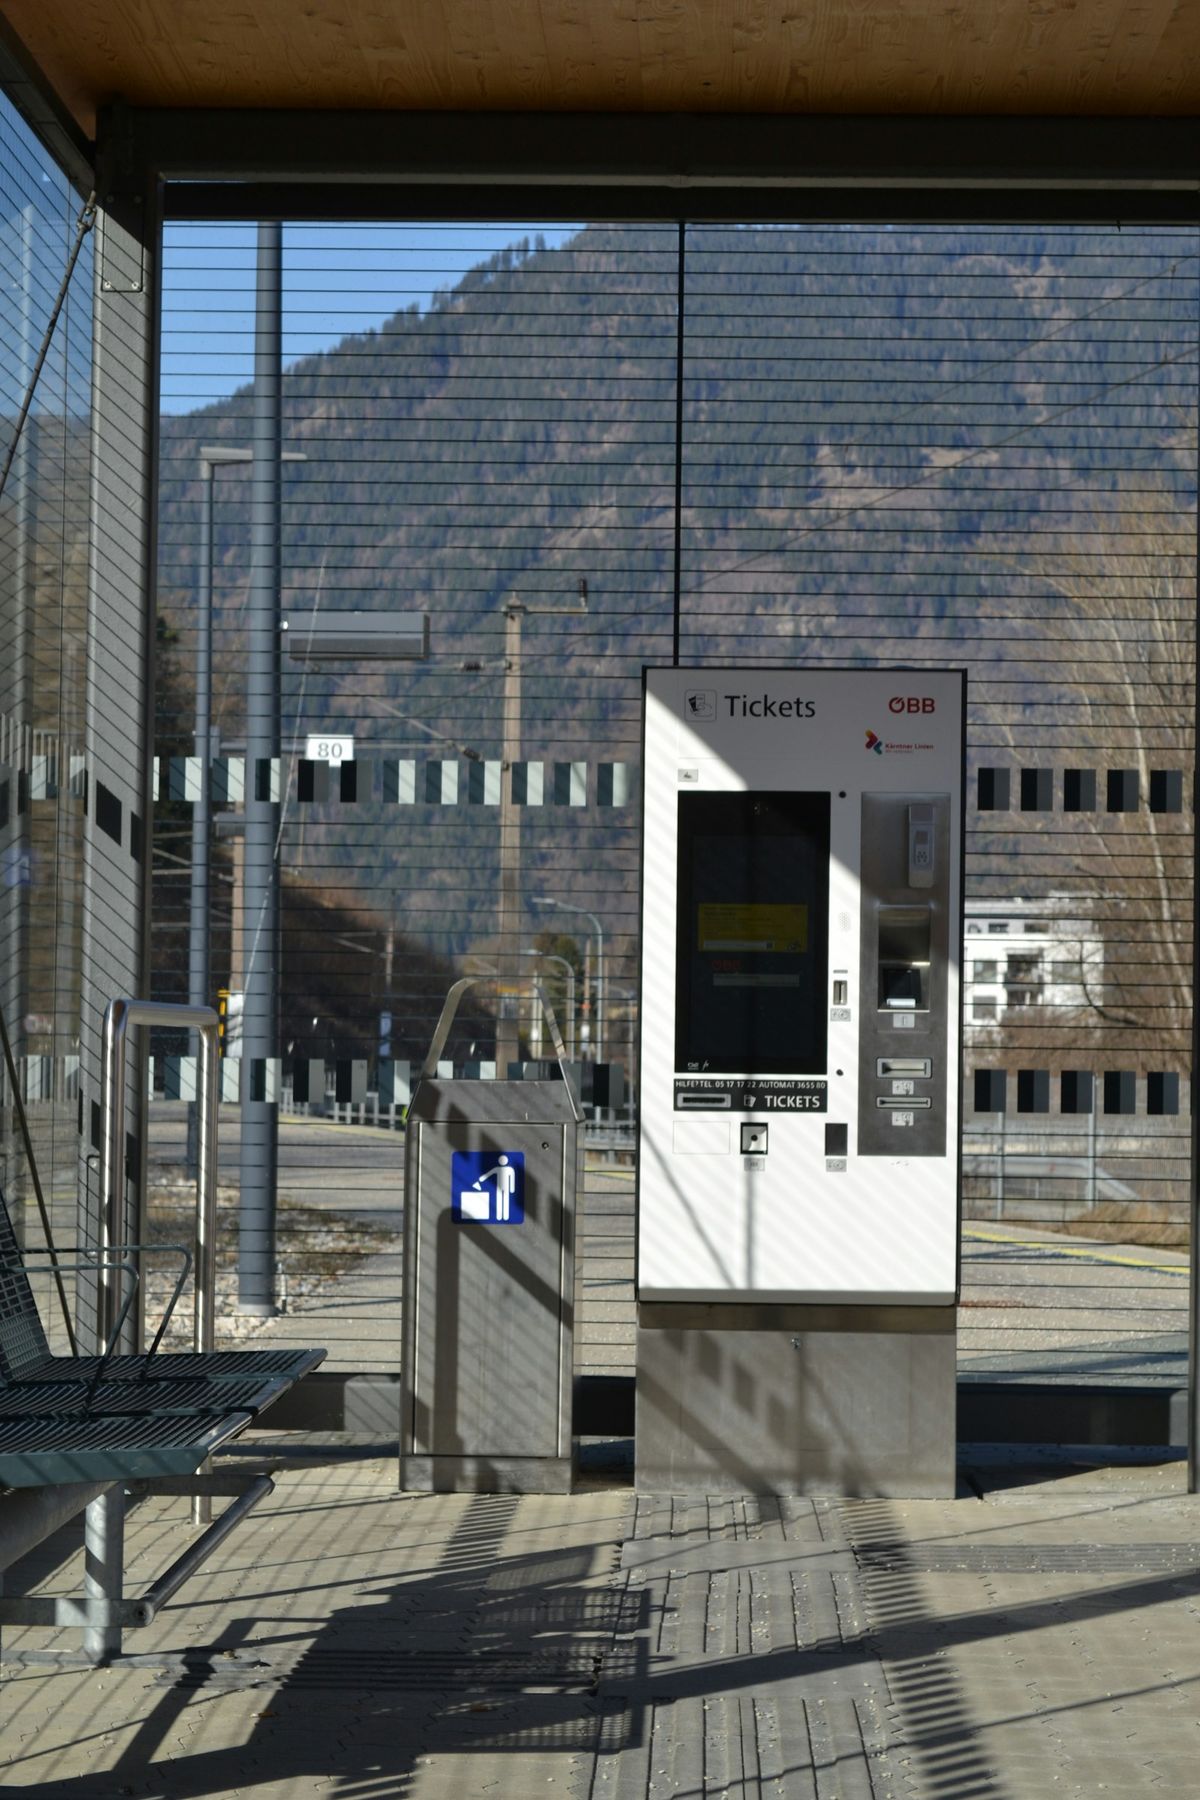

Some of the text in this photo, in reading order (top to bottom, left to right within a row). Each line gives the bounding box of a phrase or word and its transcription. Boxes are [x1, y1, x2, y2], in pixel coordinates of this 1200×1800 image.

[724, 694, 816, 718] Tickets
[317, 742, 343, 759] 80
[675, 1080, 699, 1088] HILFE?
[715, 1080, 725, 1088] 05
[726, 1080, 735, 1088] 17
[737, 1080, 745, 1088] 17
[758, 1081, 796, 1089] AUTOMAT
[764, 1095, 820, 1108] TICKETS
